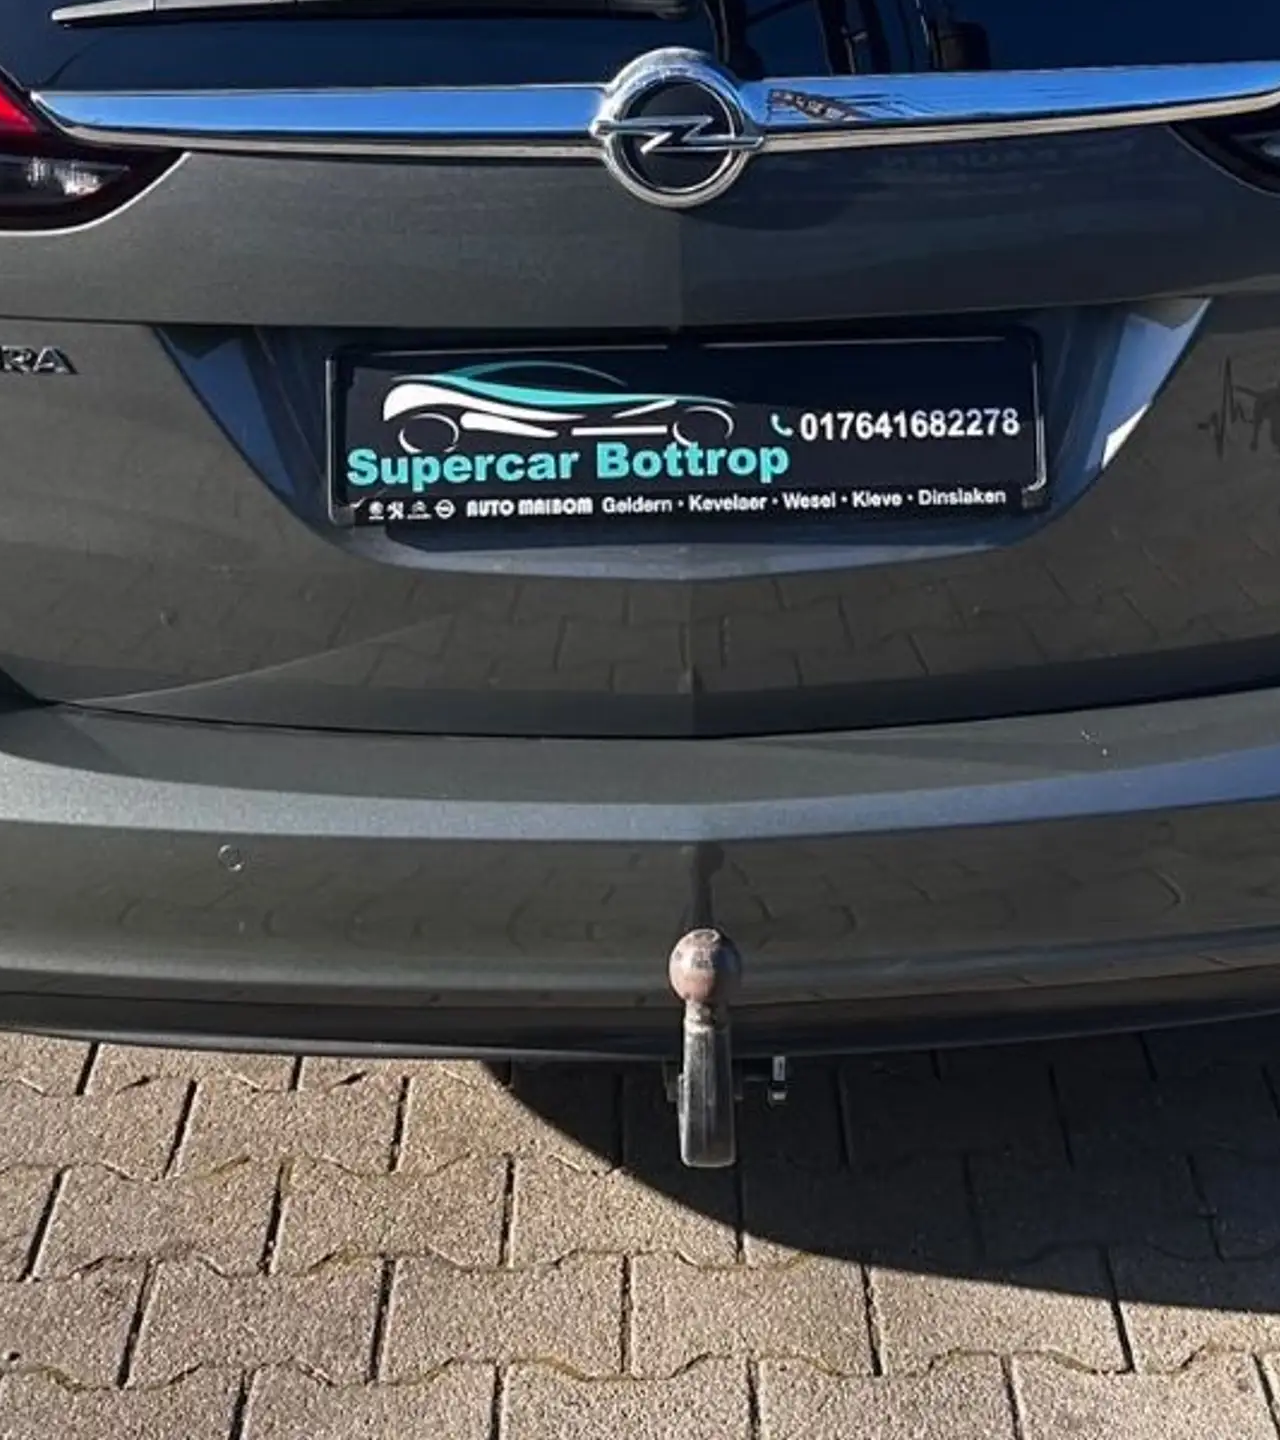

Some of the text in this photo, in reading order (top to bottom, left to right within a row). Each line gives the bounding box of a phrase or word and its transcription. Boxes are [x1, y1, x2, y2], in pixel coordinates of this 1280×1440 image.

[799, 407, 1020, 442] 017641682278
[347, 440, 790, 492] Supercar Bottrop
[466, 499, 514, 518] AUTO
[602, 496, 672, 514] Geldern
[689, 492, 767, 512] Kevelaer
[783, 491, 836, 509] Wesel
[852, 490, 903, 507] Kleve
[918, 487, 1006, 505] Dinslaken
